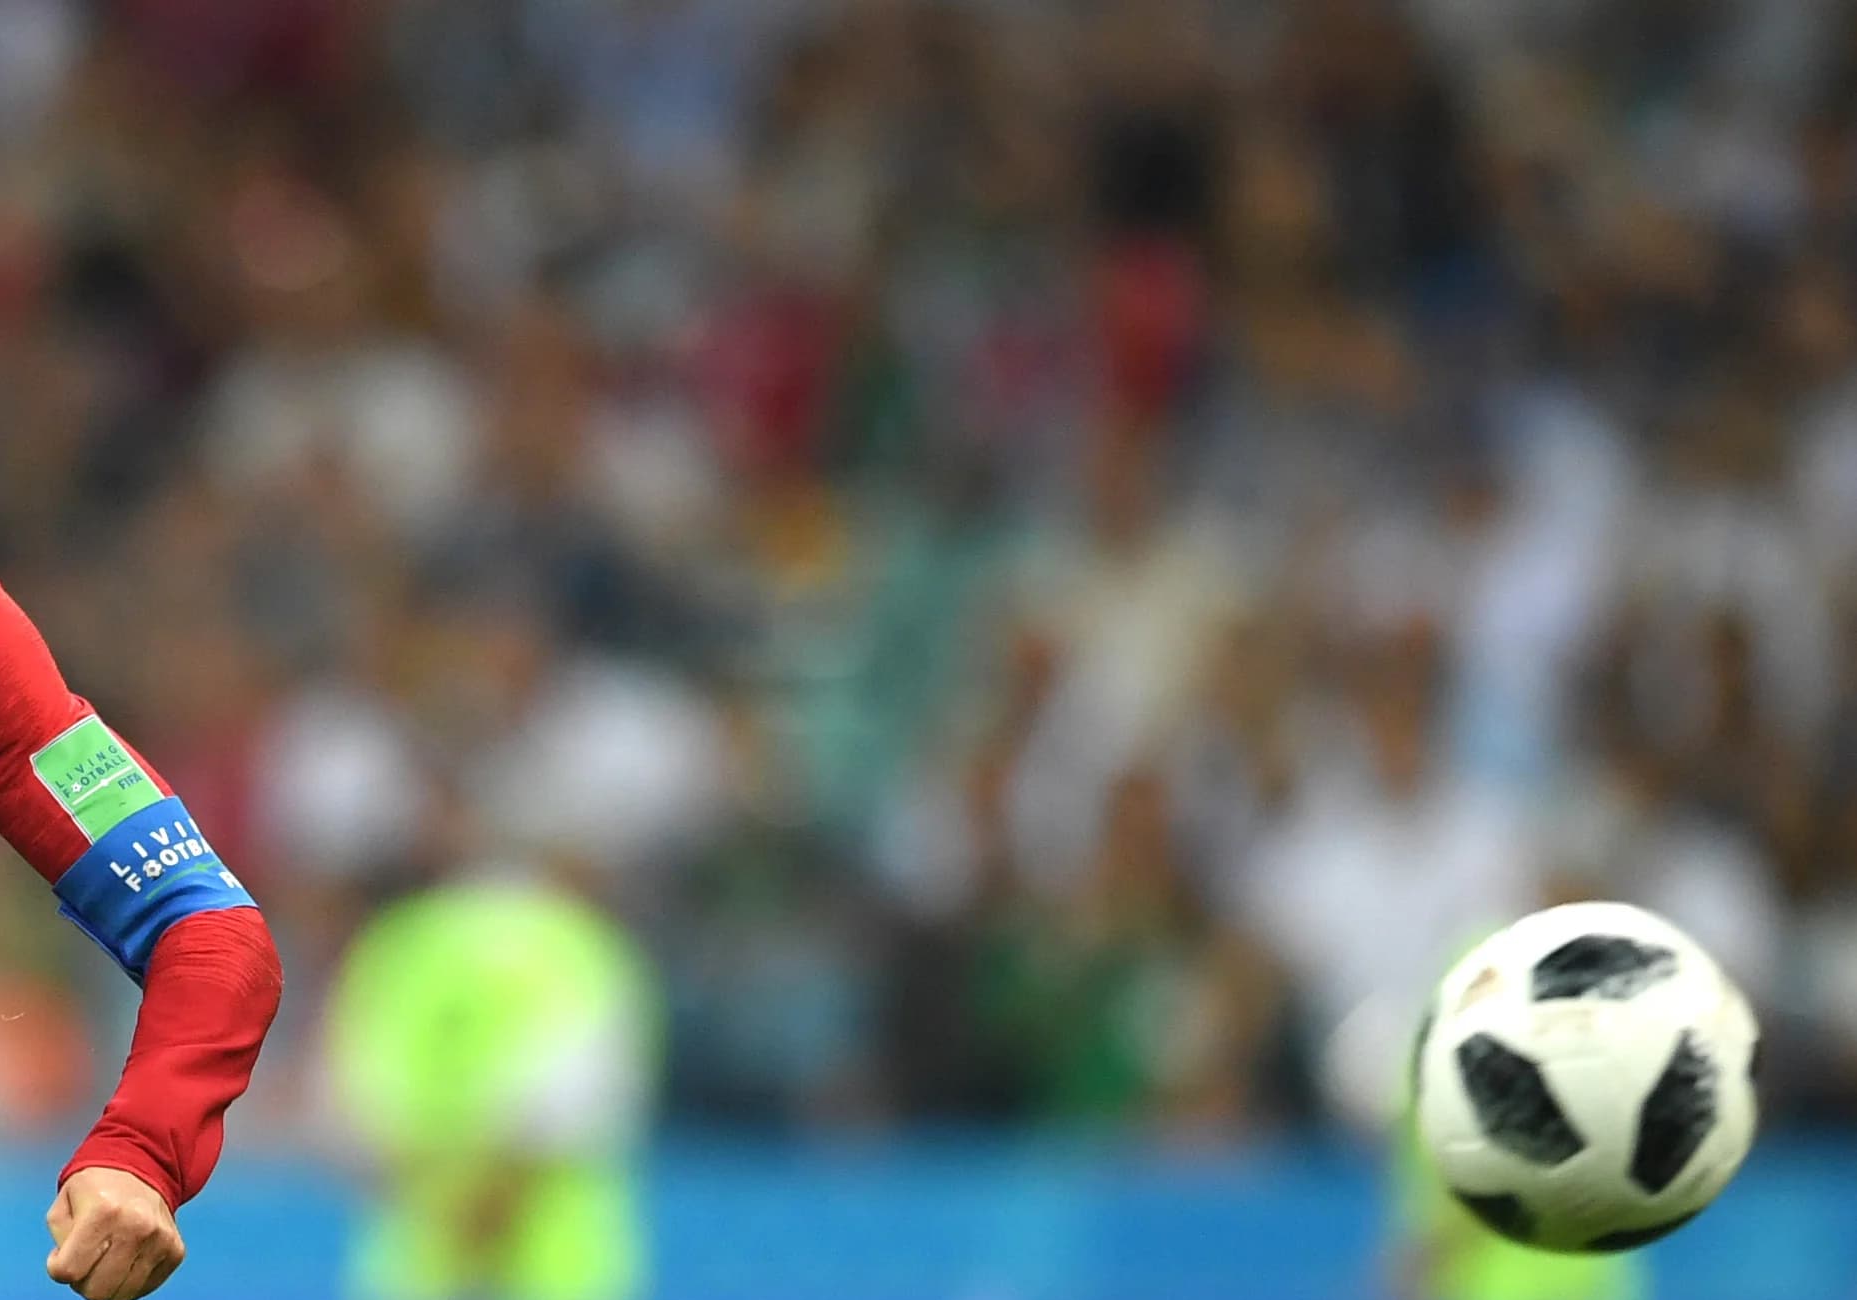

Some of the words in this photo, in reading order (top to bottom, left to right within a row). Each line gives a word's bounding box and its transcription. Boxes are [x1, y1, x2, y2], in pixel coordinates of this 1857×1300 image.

[55, 745, 118, 788] LIVING
[118, 773, 142, 790] FIFA
[109, 818, 200, 878] LIVI
